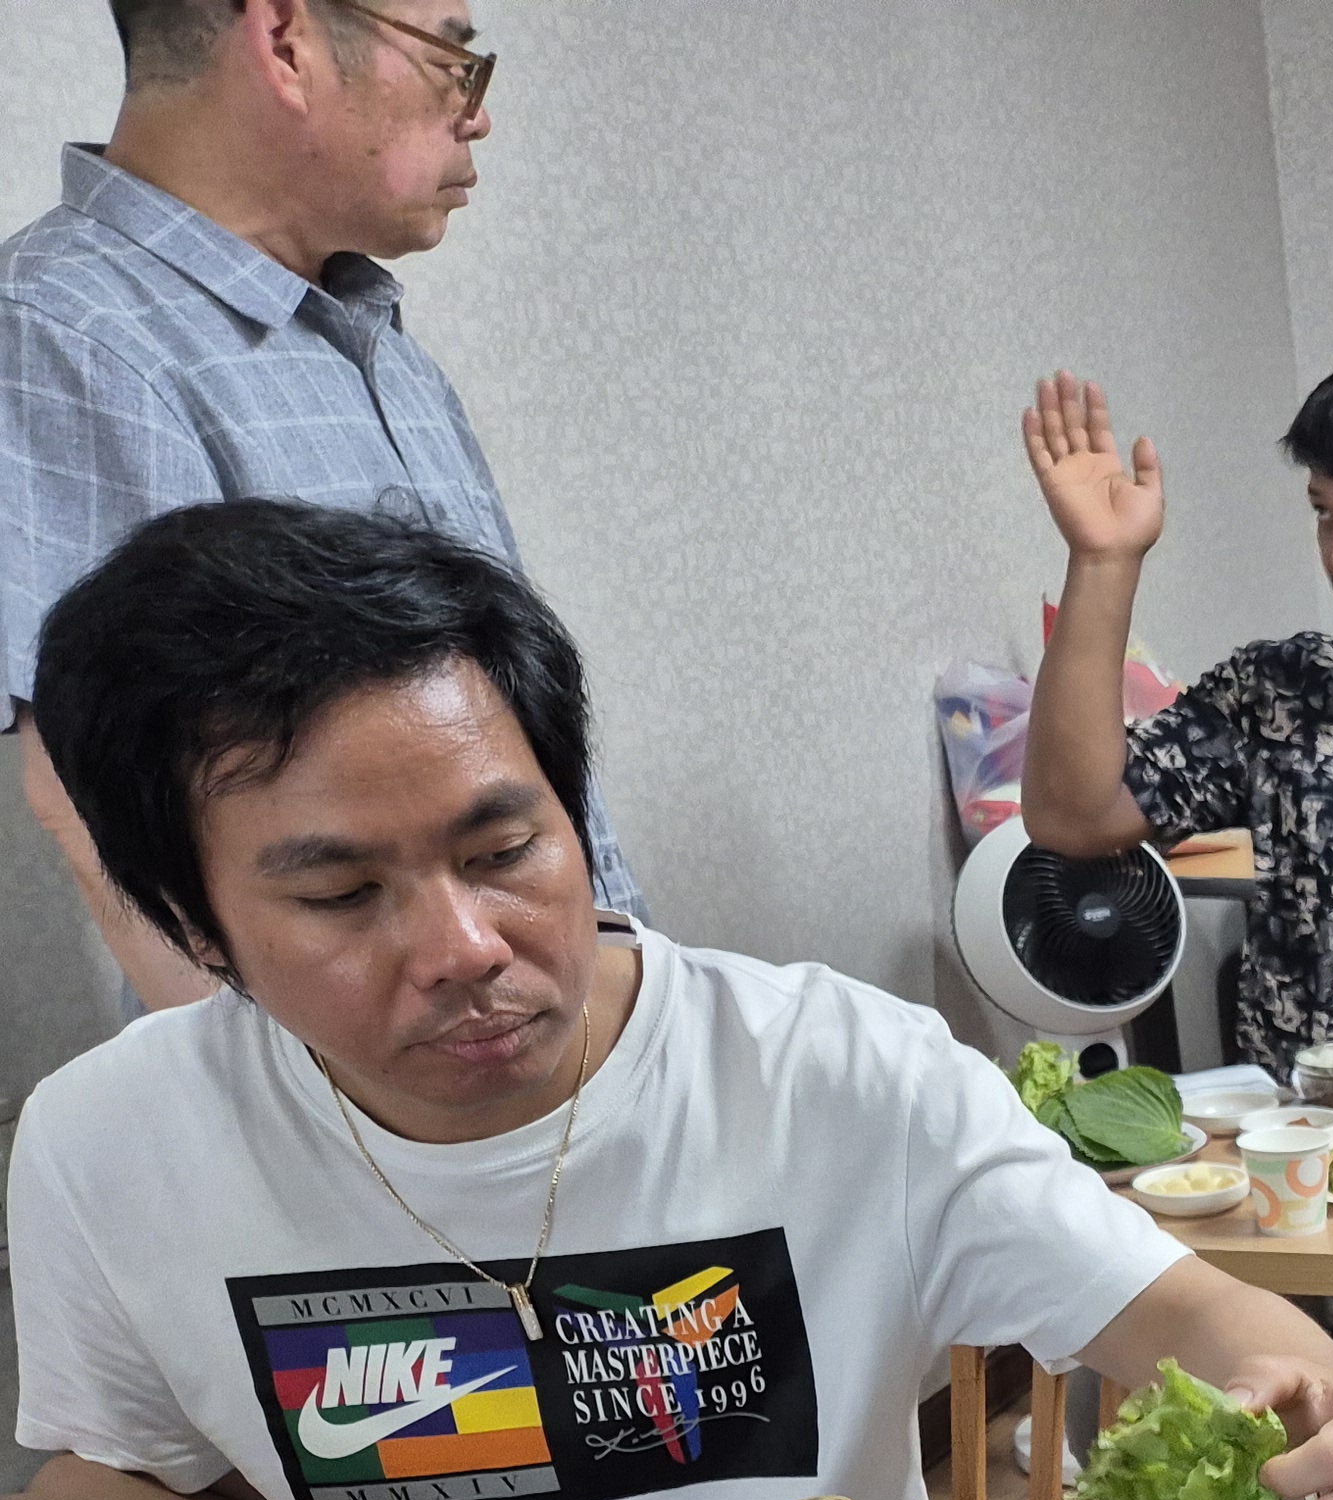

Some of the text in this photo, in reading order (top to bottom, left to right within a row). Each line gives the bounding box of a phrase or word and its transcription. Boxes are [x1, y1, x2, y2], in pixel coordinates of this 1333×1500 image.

[289, 1285, 475, 1321] MCMXCVI
[554, 1296, 756, 1346] CREATING A
[318, 1335, 457, 1409] NIKE
[561, 1330, 763, 1385] MASTERPIECE
[572, 1363, 767, 1425] SINCE 1996
